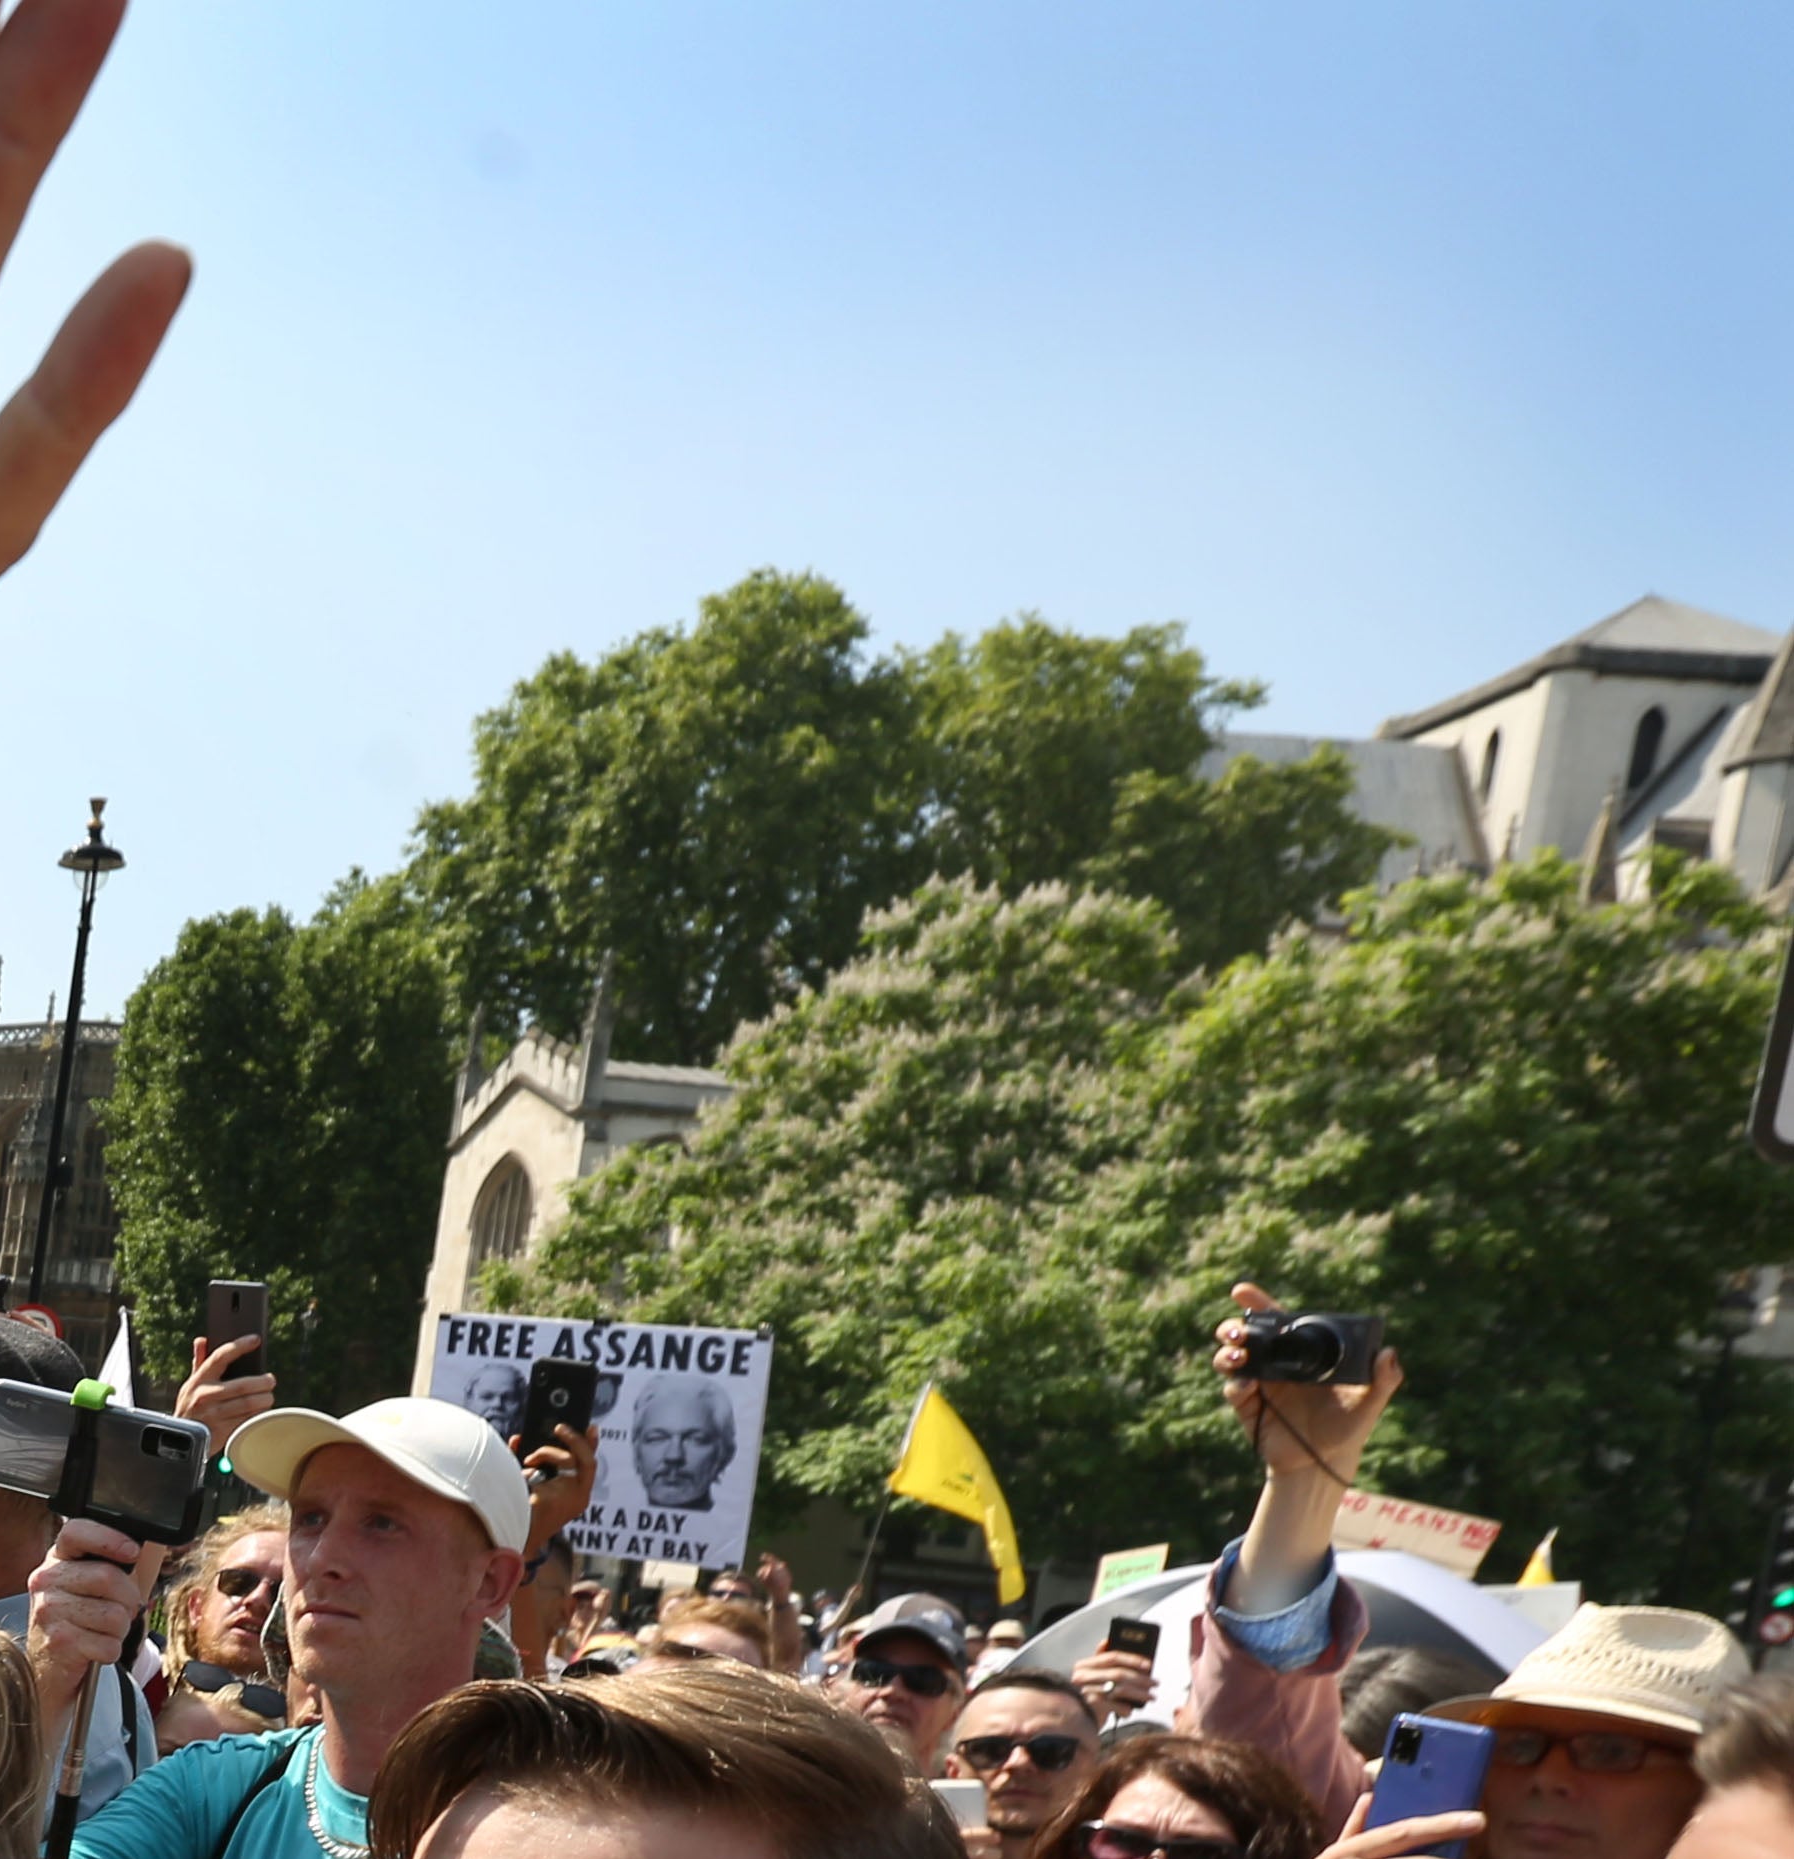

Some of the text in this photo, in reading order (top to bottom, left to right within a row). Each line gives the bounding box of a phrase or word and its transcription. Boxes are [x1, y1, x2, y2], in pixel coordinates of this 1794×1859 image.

[447, 1319, 755, 1376] FREE ASSANGE
[573, 1504, 687, 1535] AK A DAY
[568, 1527, 710, 1562] NNY AT BAY
